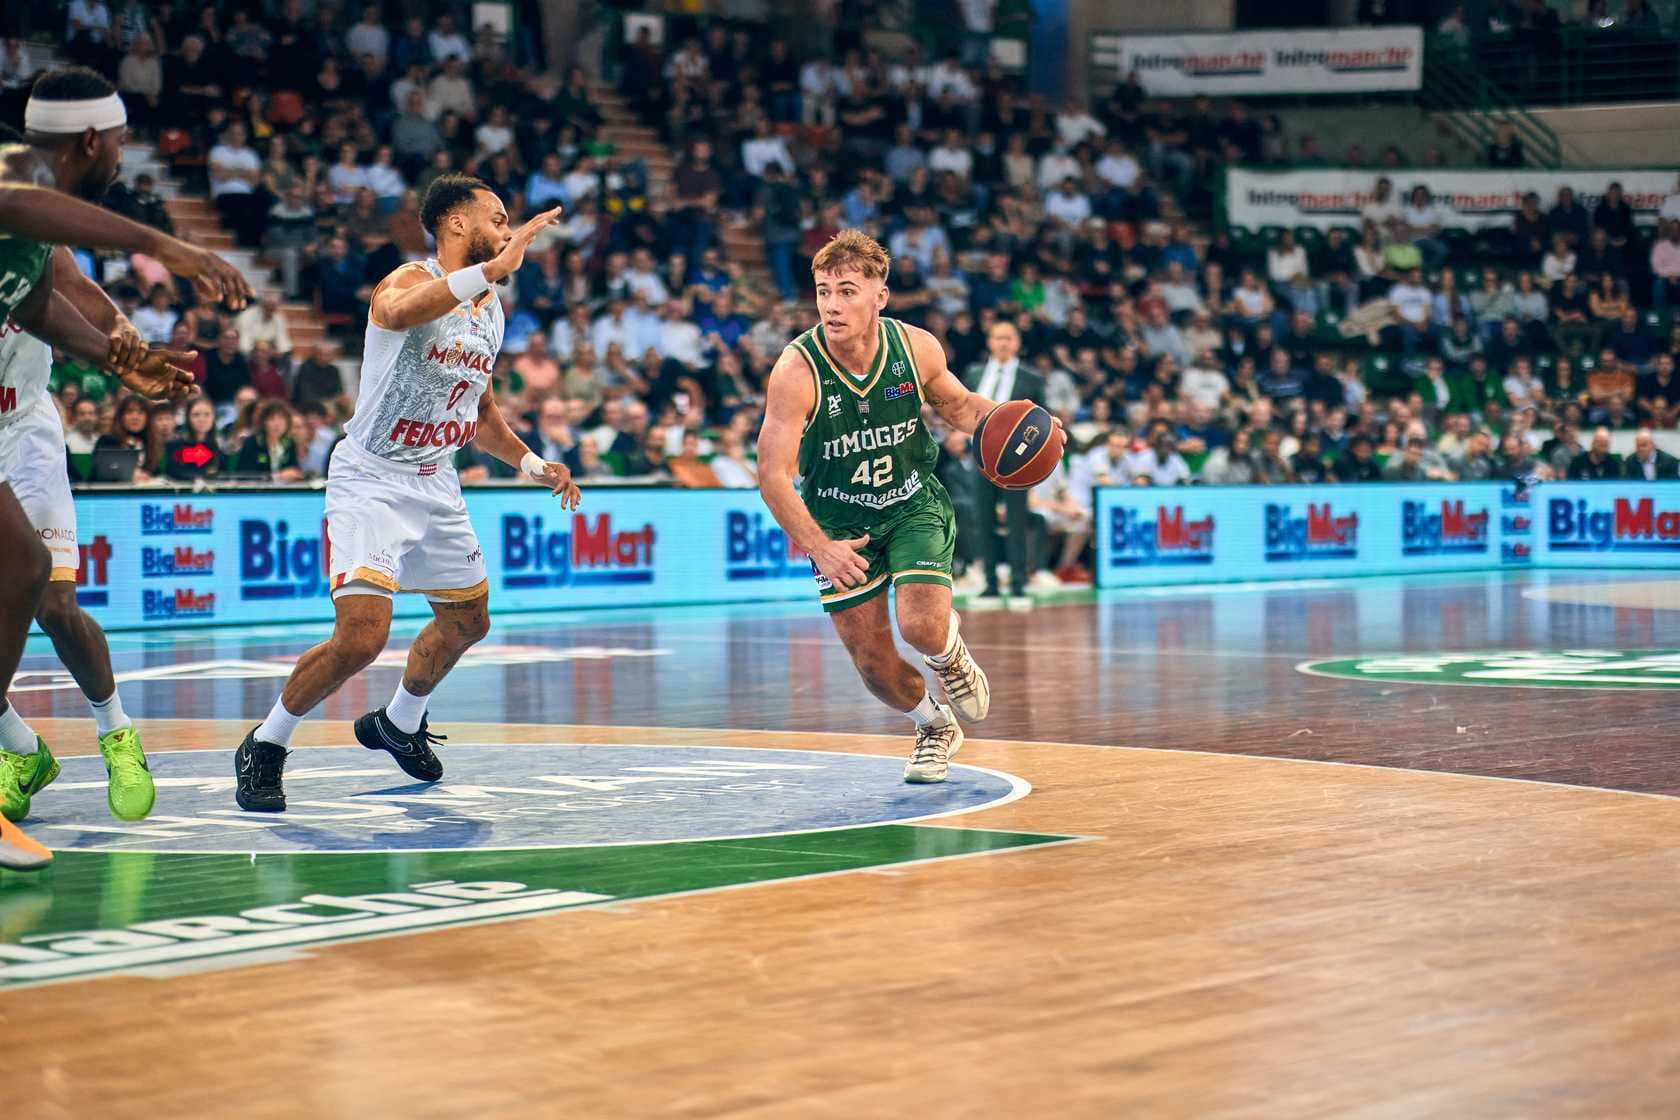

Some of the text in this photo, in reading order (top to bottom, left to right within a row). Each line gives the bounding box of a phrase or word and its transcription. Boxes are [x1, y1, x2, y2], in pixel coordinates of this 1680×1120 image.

[390, 418, 477, 448] FEDCOM
[851, 455, 894, 488] 42
[141, 504, 214, 531] BigMat
[1549, 497, 1680, 549] BigMa
[142, 547, 215, 574] BigMat
[502, 512, 655, 585] BigMat
[142, 588, 215, 616] BigMat
